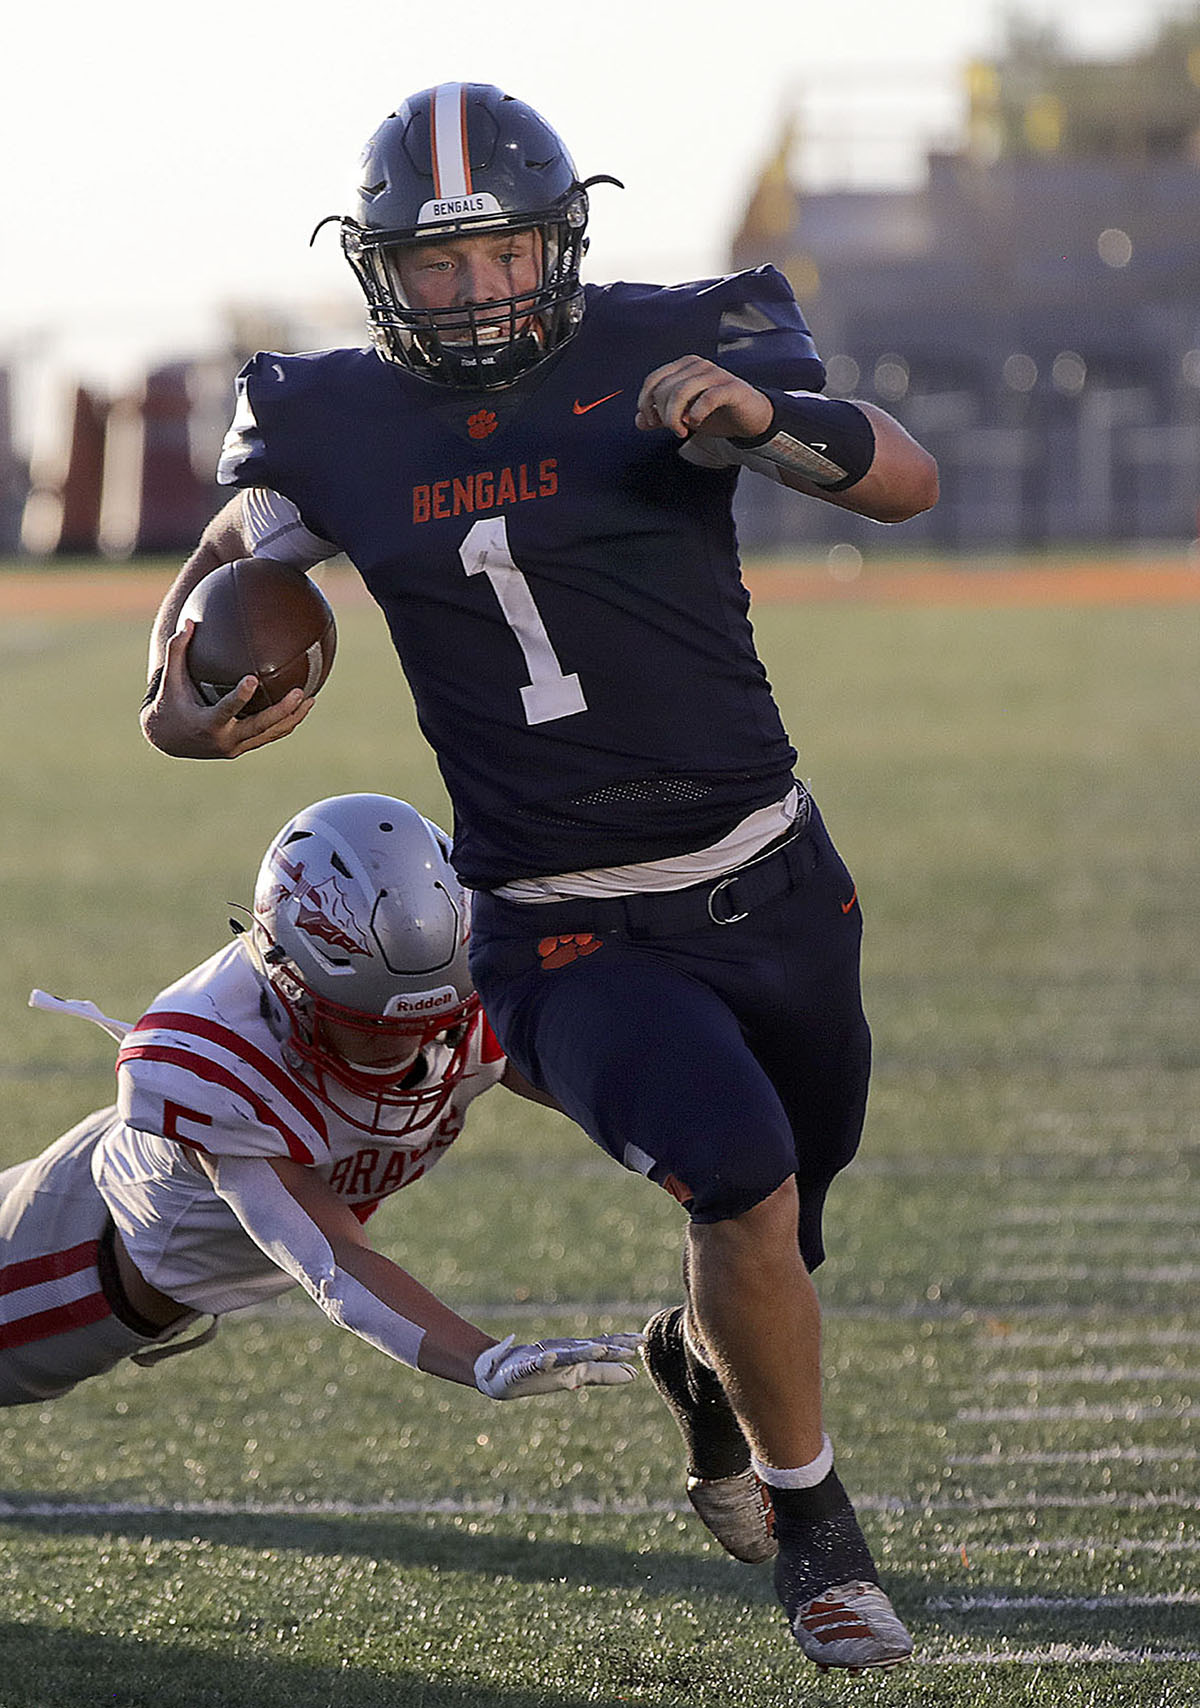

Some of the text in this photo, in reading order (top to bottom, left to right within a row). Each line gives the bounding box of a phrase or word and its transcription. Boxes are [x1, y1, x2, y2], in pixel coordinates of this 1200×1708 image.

[434, 198, 484, 216] BENGALS
[412, 458, 559, 524] BENGALS
[458, 515, 588, 726] 1
[396, 993, 452, 1012] Riddell
